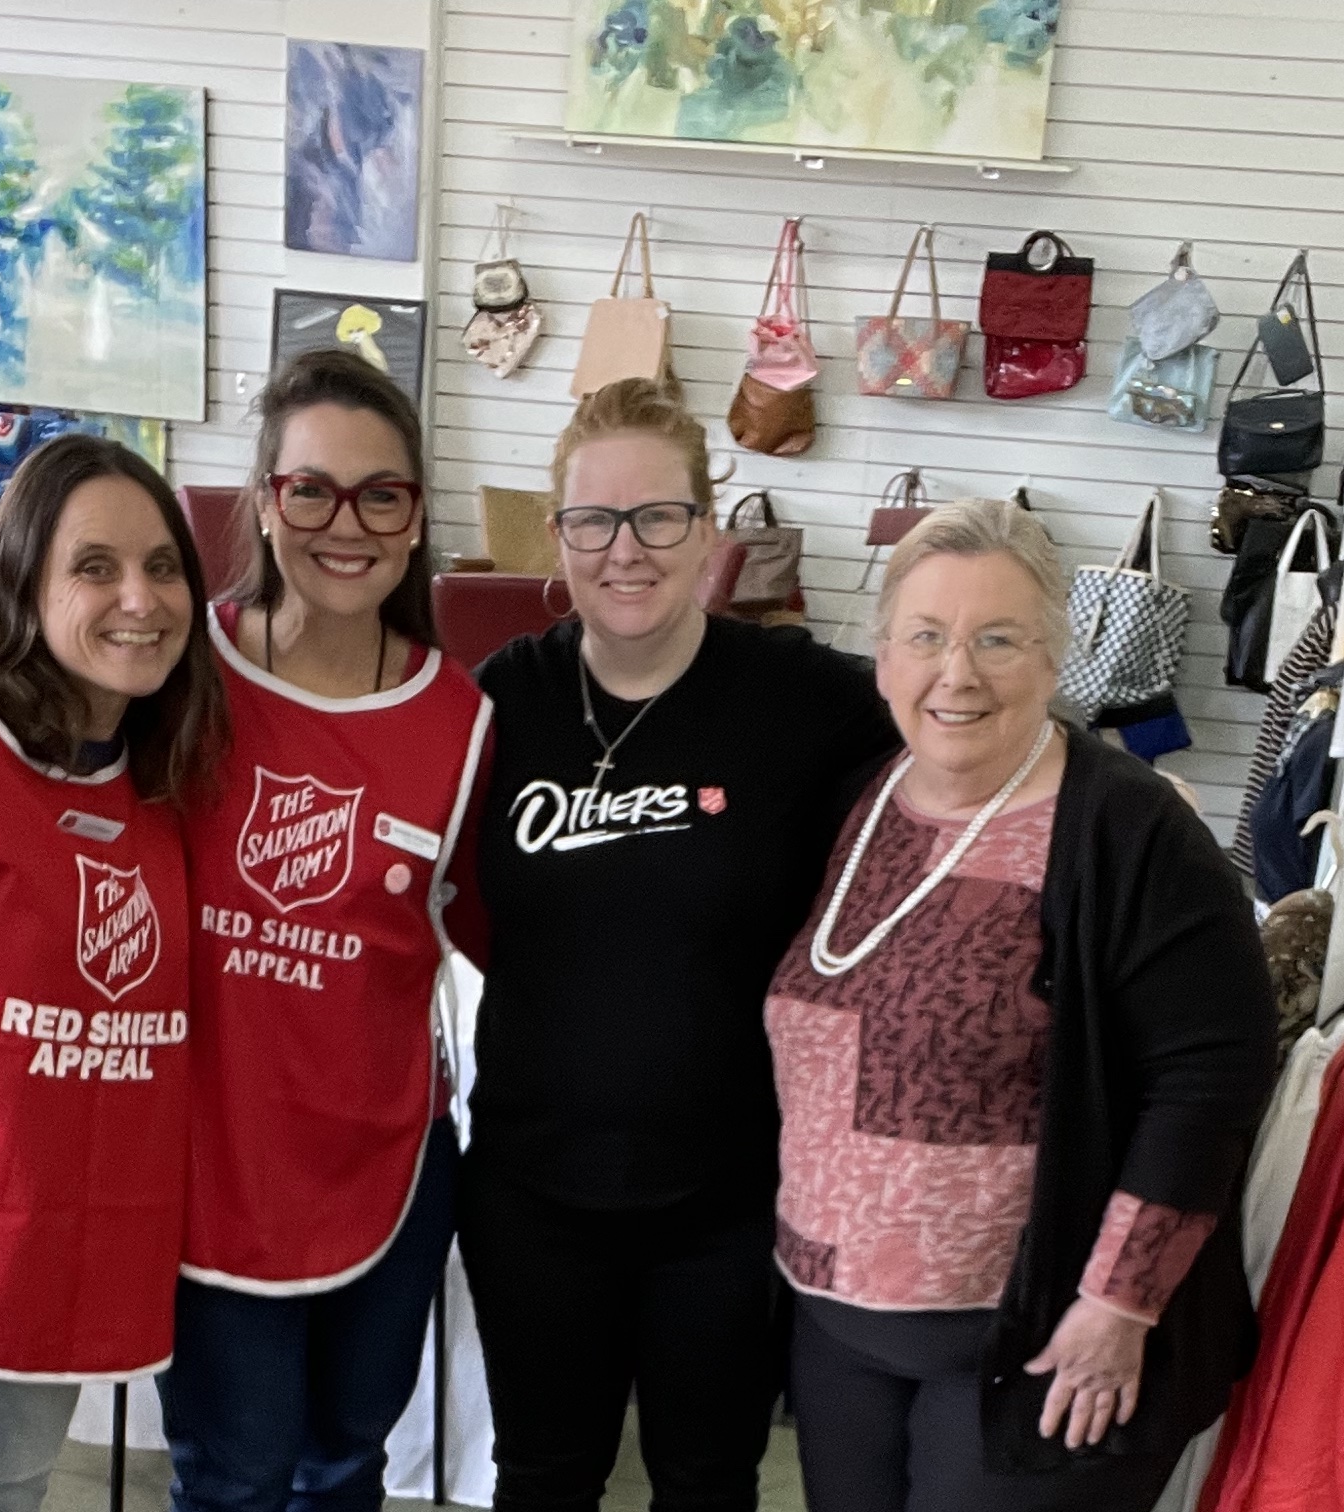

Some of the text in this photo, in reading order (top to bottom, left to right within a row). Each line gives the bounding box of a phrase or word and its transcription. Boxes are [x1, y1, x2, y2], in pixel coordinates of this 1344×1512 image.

[268, 785, 316, 823] THE
[243, 801, 352, 868] SALVATION
[272, 838, 342, 892] ARMY
[104, 916, 152, 983] ARMY
[201, 903, 363, 961] RED SHIELD
[222, 946, 324, 991] APPEAL
[0, 997, 188, 1046] RED SHIELD
[28, 1042, 154, 1080] APPEAL
